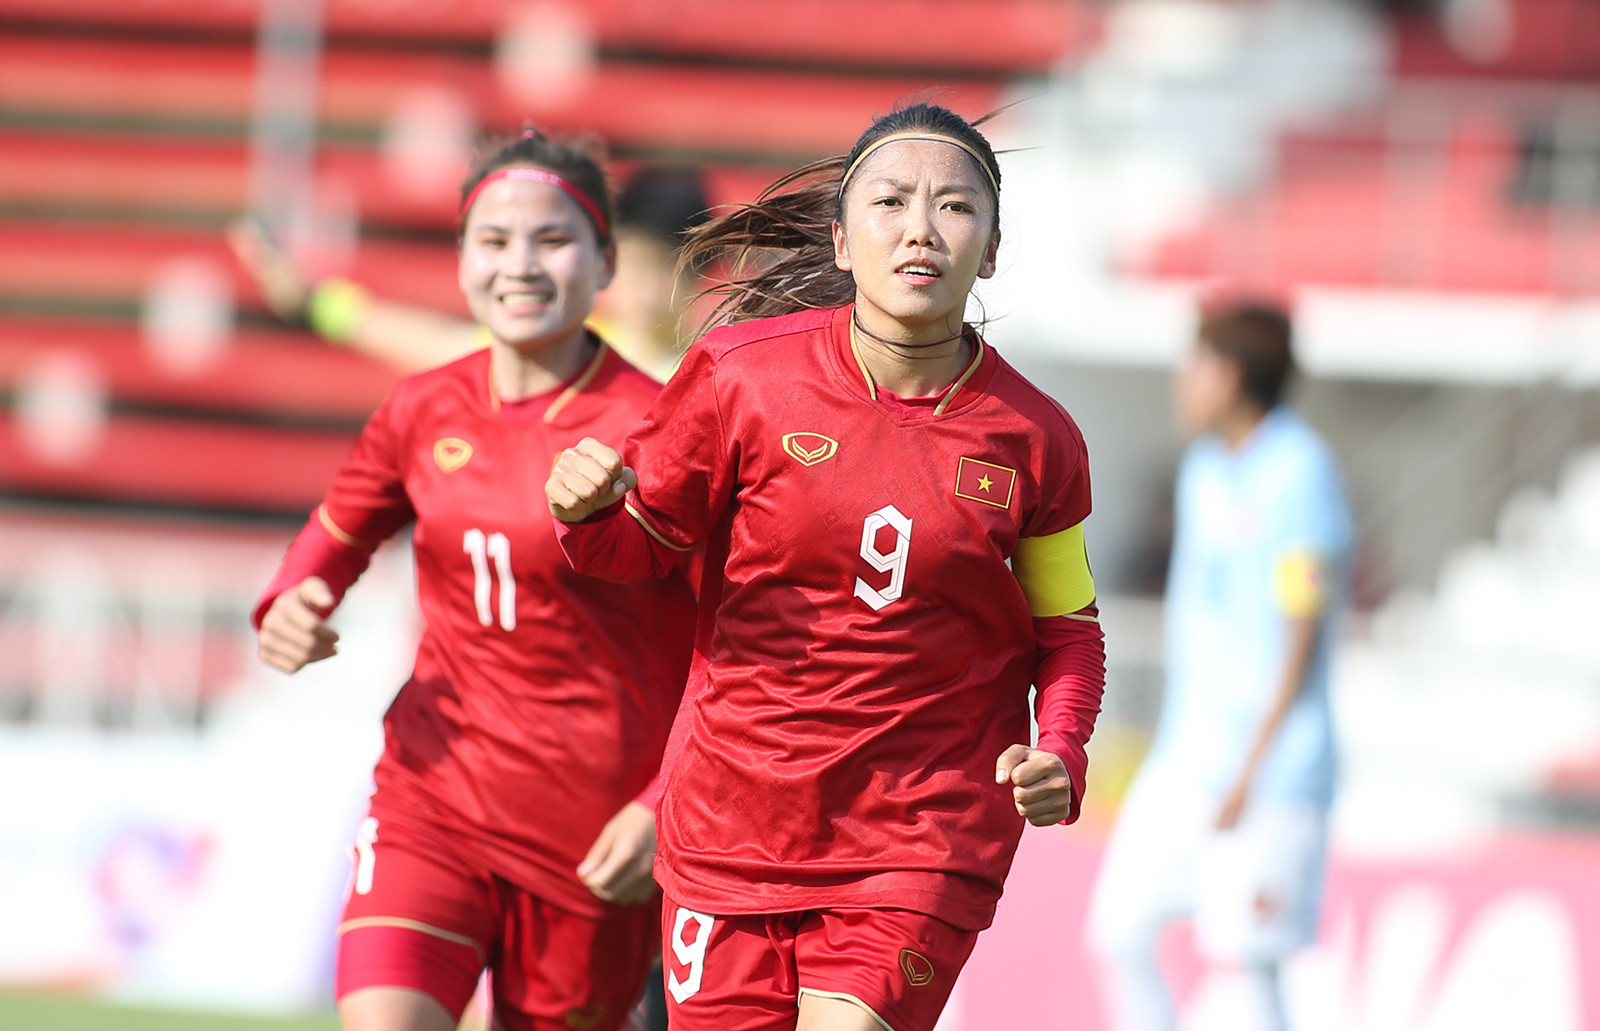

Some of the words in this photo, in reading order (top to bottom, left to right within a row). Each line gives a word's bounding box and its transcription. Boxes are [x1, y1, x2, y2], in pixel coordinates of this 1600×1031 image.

[463, 528, 517, 632] 11
[853, 504, 914, 611] 9
[668, 907, 716, 1005] 9
